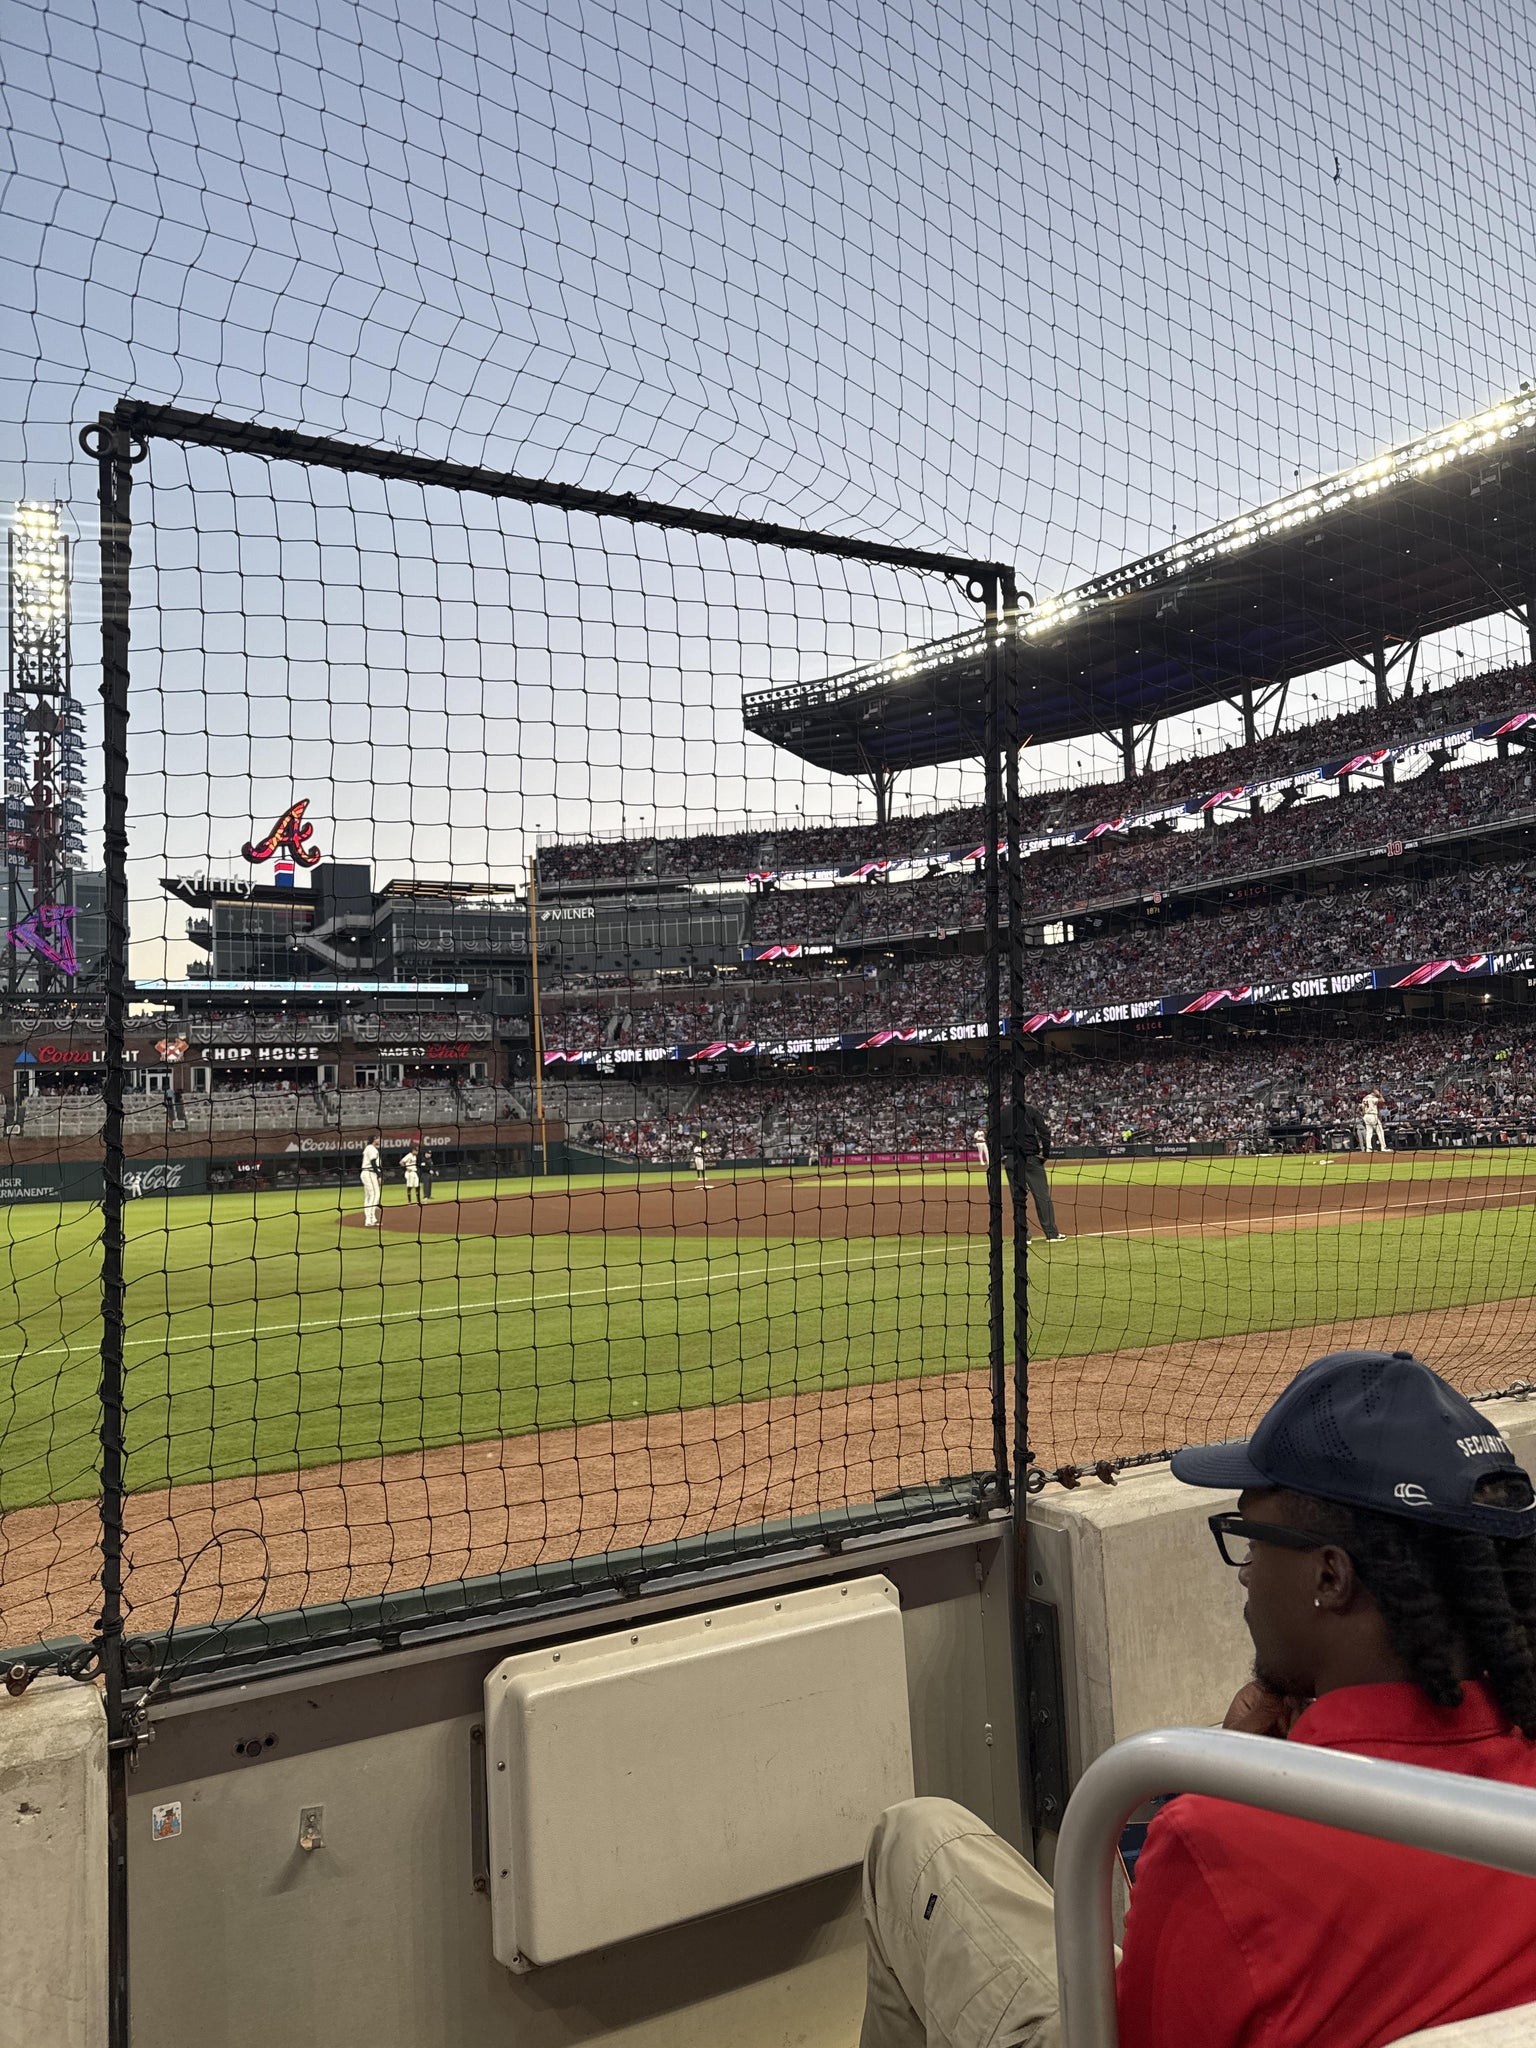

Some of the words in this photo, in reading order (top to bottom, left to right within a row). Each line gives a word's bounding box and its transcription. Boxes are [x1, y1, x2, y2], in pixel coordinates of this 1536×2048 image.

[1387, 840, 1403, 857] 10
[1237, 886, 1268, 897] SLICE
[552, 907, 595, 920] MILNER
[1291, 977, 1328, 999] SOME
[1330, 972, 1373, 994] NOISE
[1102, 1003, 1130, 1024] SOME
[949, 1024, 976, 1041] SOME
[38, 1044, 90, 1064] Coors
[92, 1050, 140, 1062] LIHT
[201, 1047, 252, 1061] CHOP
[258, 1047, 320, 1060] HOUSE
[378, 1047, 409, 1057] MADE
[410, 1047, 426, 1057] TO
[787, 1038, 813, 1054] SOME
[613, 1047, 643, 1063] SOME
[300, 1138, 336, 1151] Coors
[376, 1138, 412, 1148] ELOW
[1154, 1146, 1188, 1154] Booking.com
[0, 1178, 22, 1187] ISER
[1456, 1434, 1512, 1458] SECURIT
